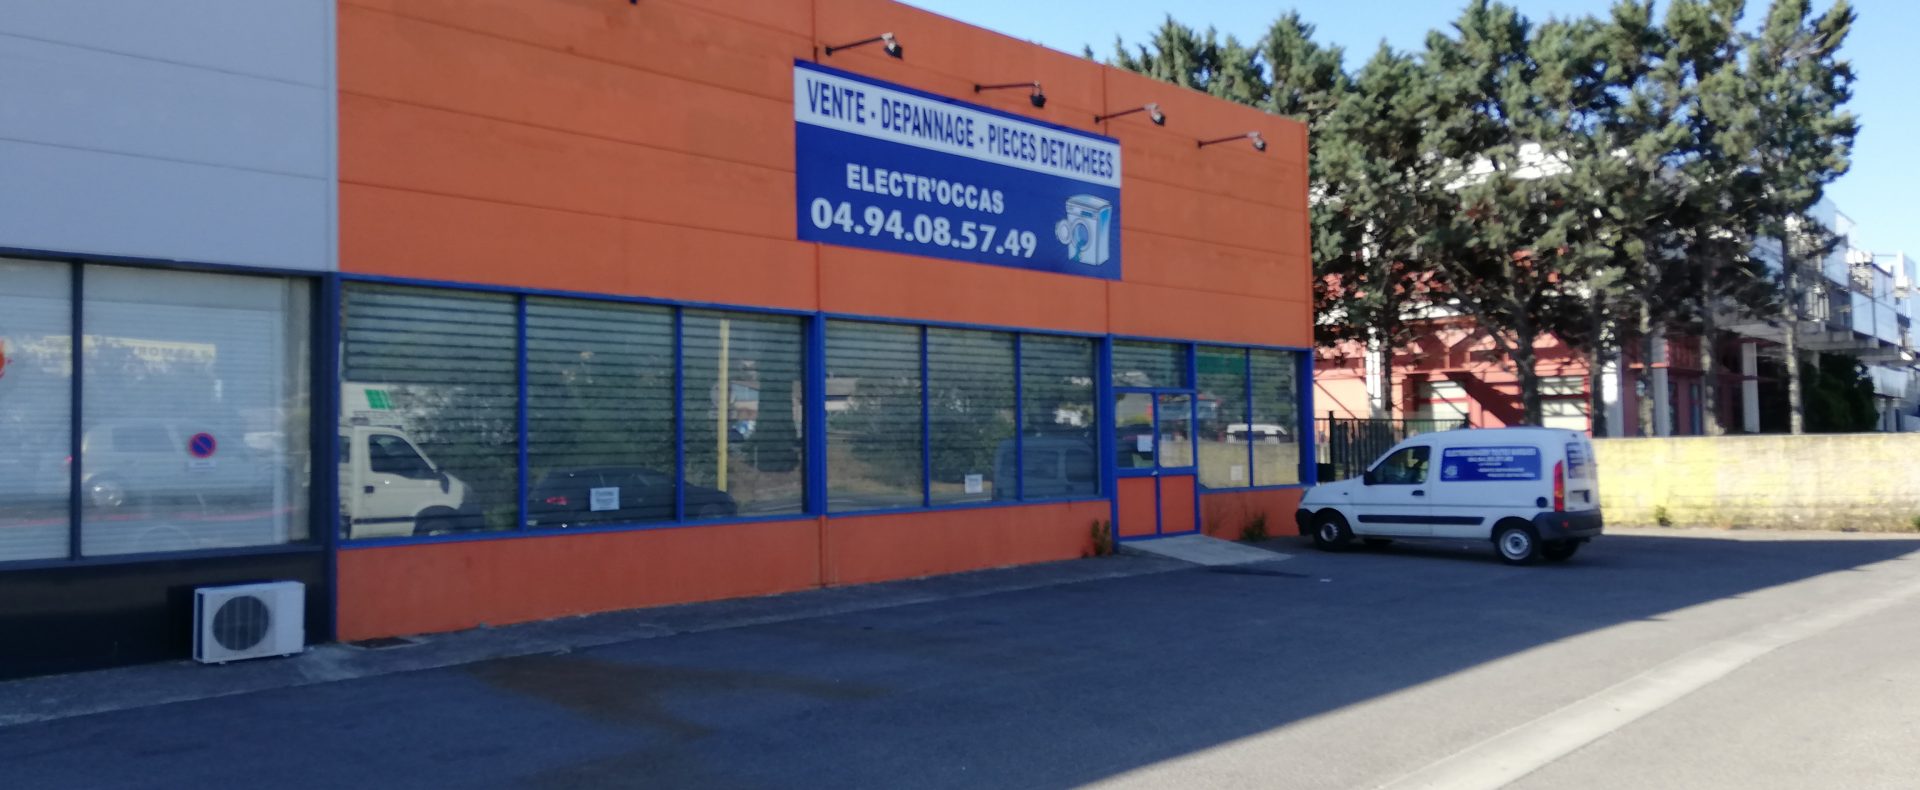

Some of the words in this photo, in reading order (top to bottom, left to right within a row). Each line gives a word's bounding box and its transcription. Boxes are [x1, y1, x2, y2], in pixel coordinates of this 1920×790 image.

[807, 79, 865, 124] VENTE
[881, 97, 974, 148] DEPANNAGE
[988, 123, 1036, 163] PIECES
[1041, 136, 1113, 179] DETACHEES
[847, 163, 1004, 214] ELECTR'OCCAS
[811, 197, 1037, 258] 04.94.08.57.49
